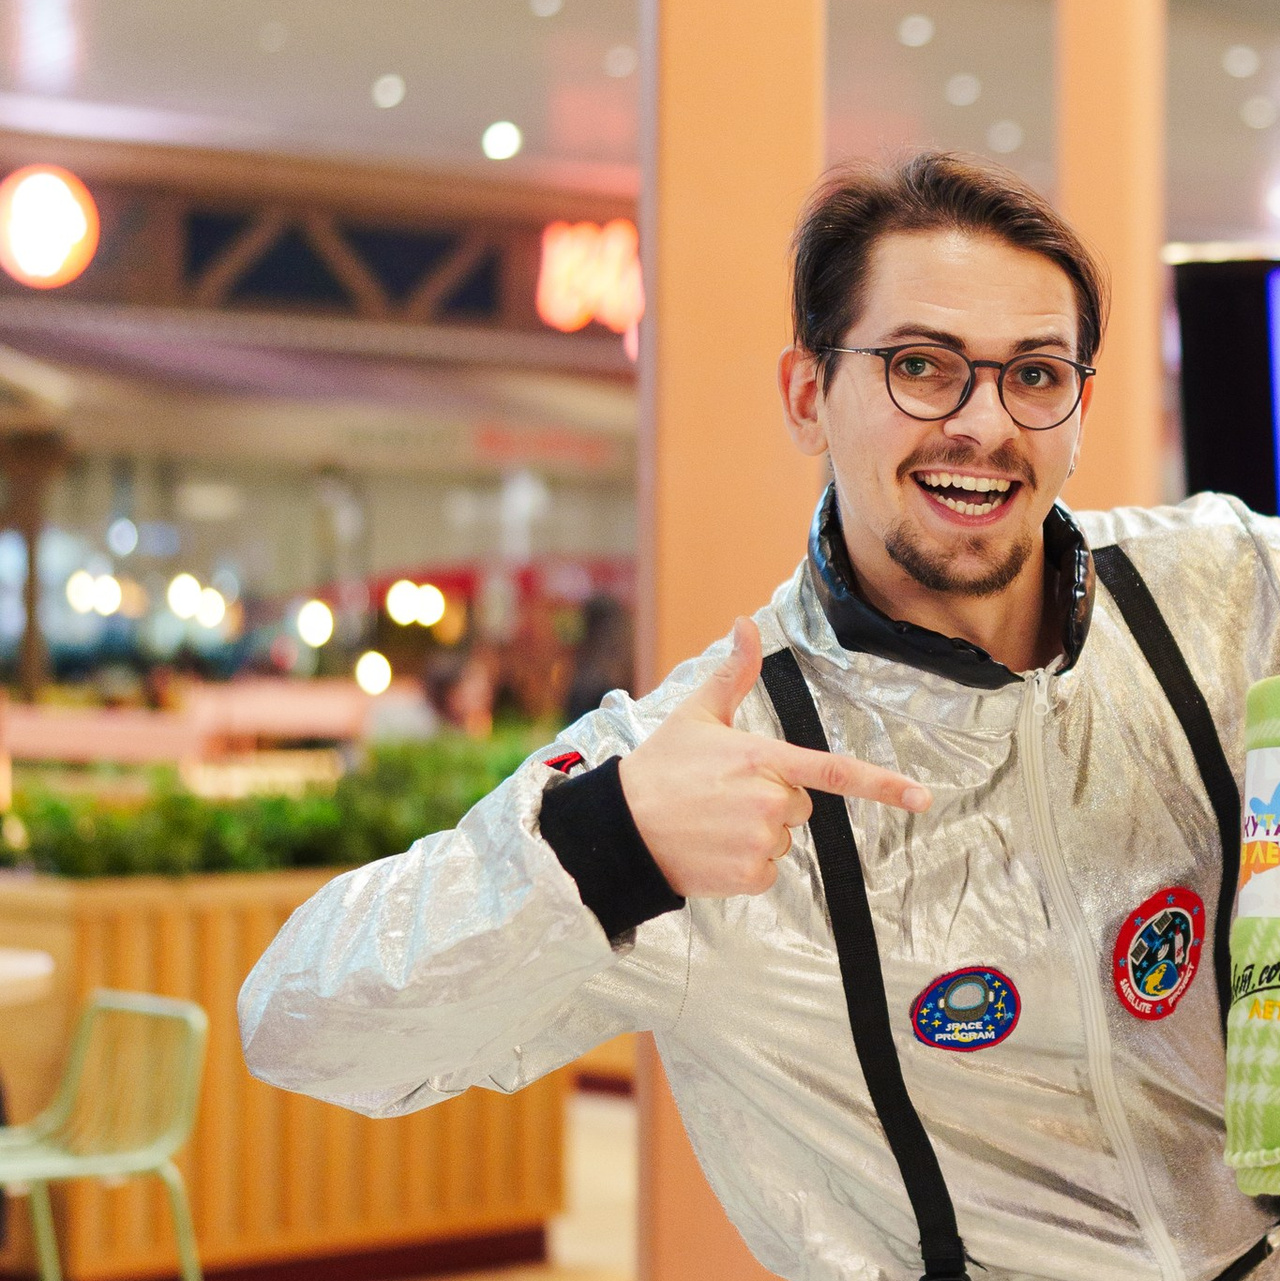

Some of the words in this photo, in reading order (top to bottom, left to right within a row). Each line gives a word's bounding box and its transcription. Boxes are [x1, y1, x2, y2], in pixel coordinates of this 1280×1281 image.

[1120, 978, 1153, 1014] SATELLITE
[945, 1021, 984, 1032] SPACE
[935, 1031, 996, 1042] PROGRAM
